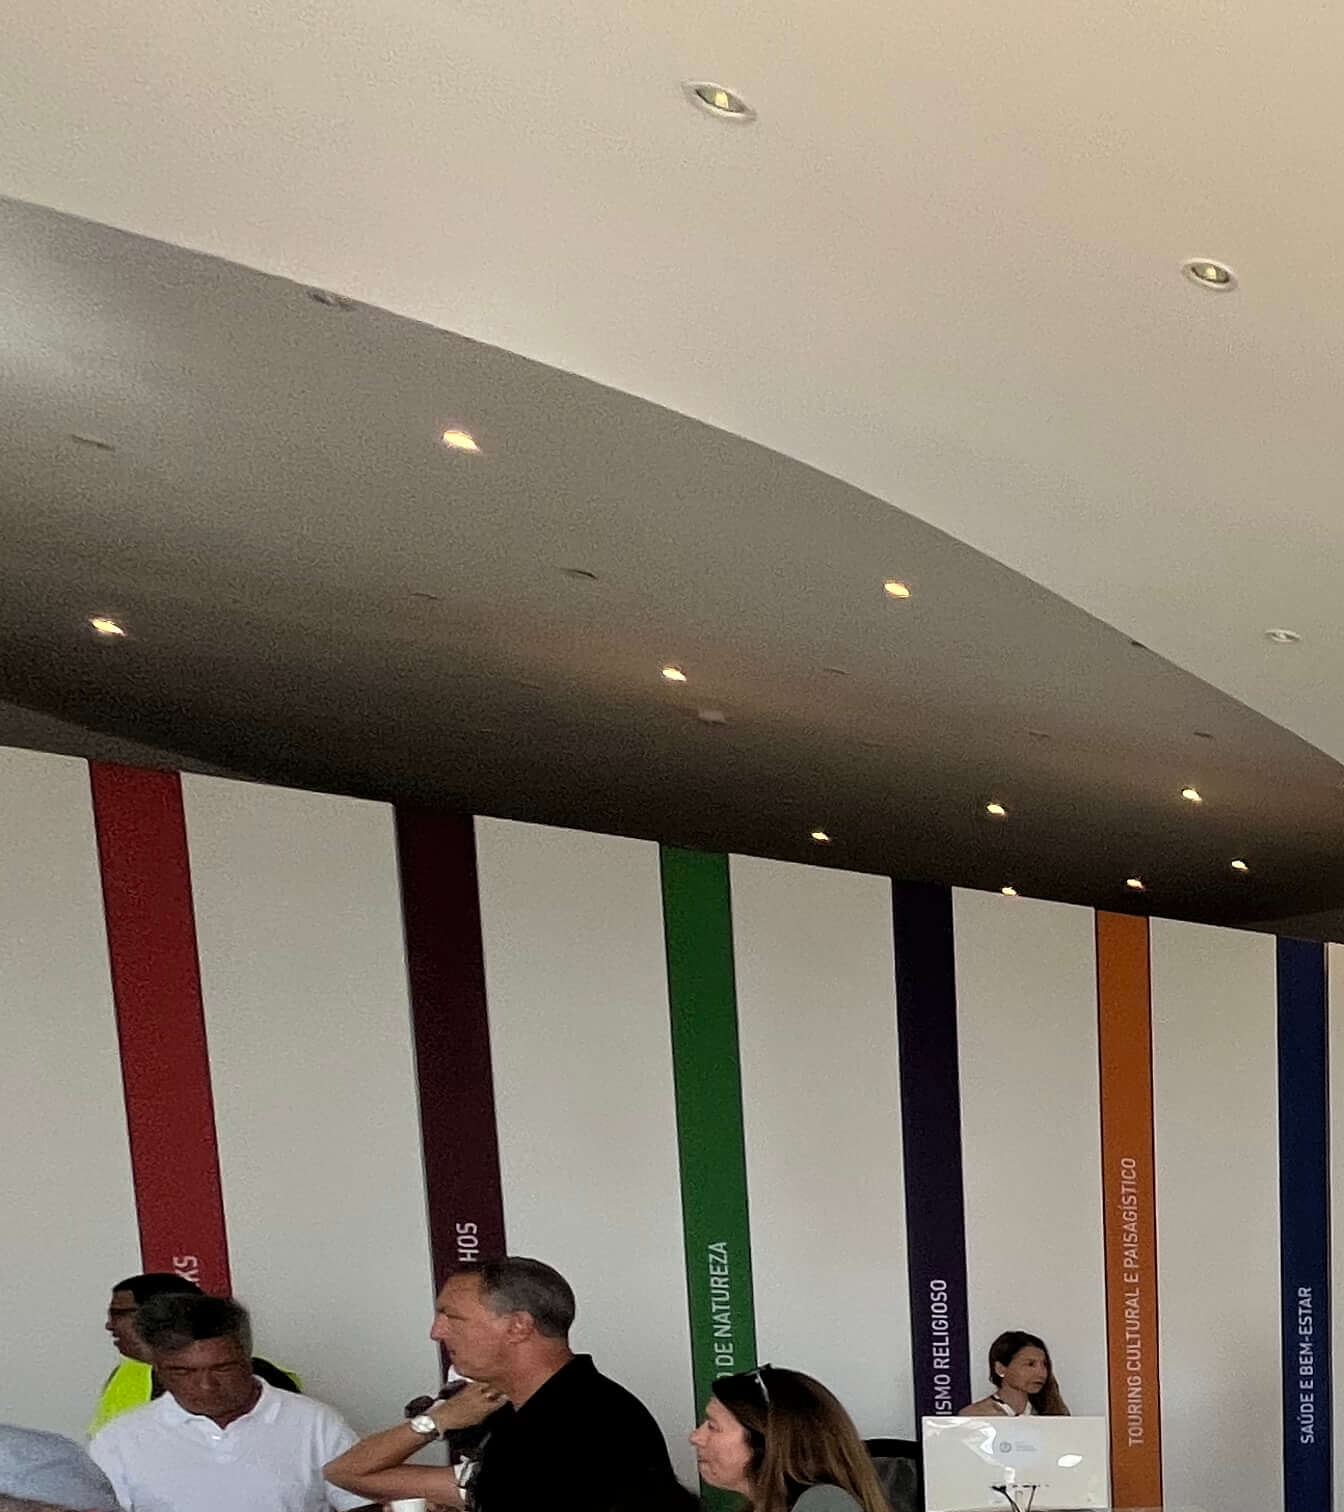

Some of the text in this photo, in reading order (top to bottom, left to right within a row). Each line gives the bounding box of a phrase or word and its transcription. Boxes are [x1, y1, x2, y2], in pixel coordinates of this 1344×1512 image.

[456, 1222, 480, 1262] HOS
[708, 1241, 733, 1338] NATUREZA
[714, 1342, 735, 1366] DE
[930, 1279, 953, 1416] ISMO RELIGIOSO
[1118, 1157, 1145, 1448] TOURING CULTURAL E PAISAGÍSTICO
[1297, 1287, 1315, 1444] SAÚDE E BEM-ESTAR
